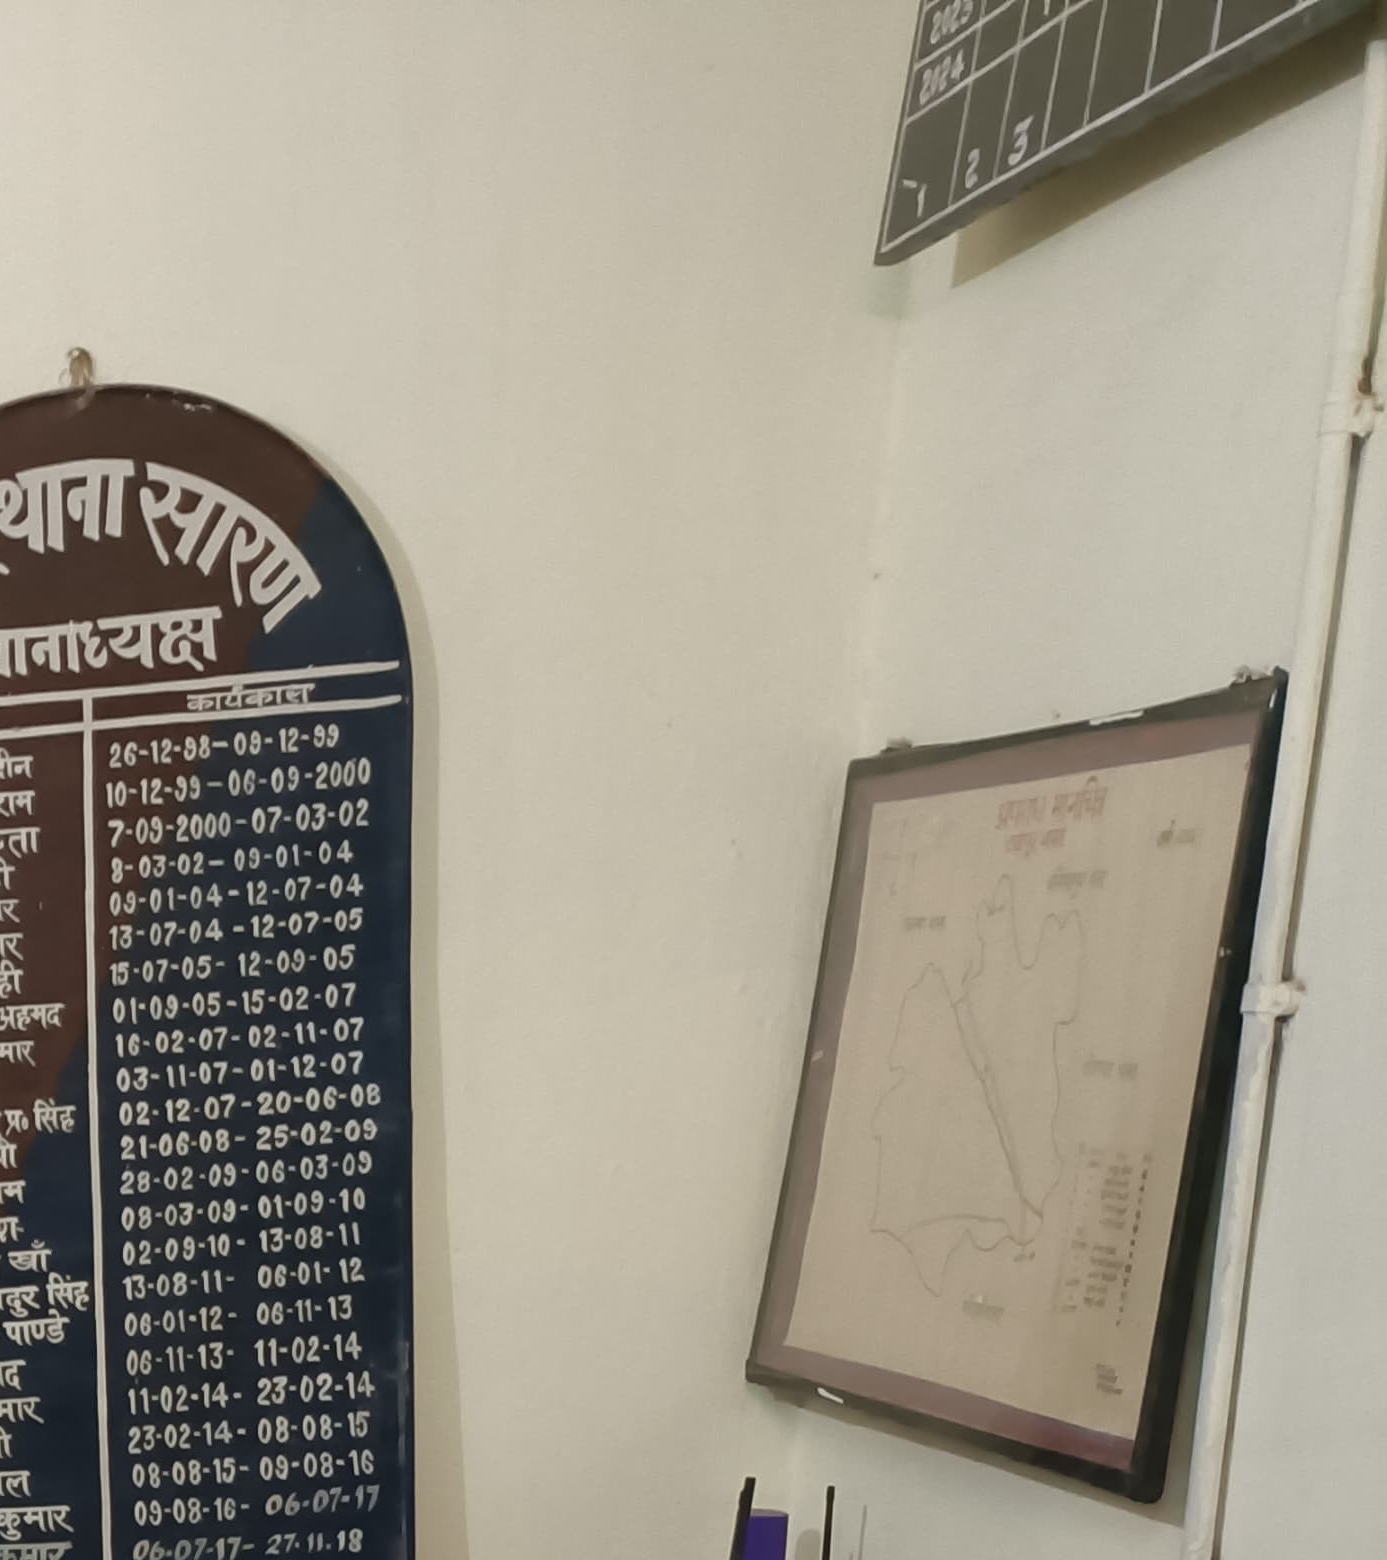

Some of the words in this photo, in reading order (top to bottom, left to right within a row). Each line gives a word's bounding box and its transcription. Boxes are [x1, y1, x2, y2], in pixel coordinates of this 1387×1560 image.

[919, 49, 965, 104] 2024
[139, 461, 321, 634] सारण
[33, 1099, 76, 1133] सिंह
[46, 1272, 89, 1310] सिंह
